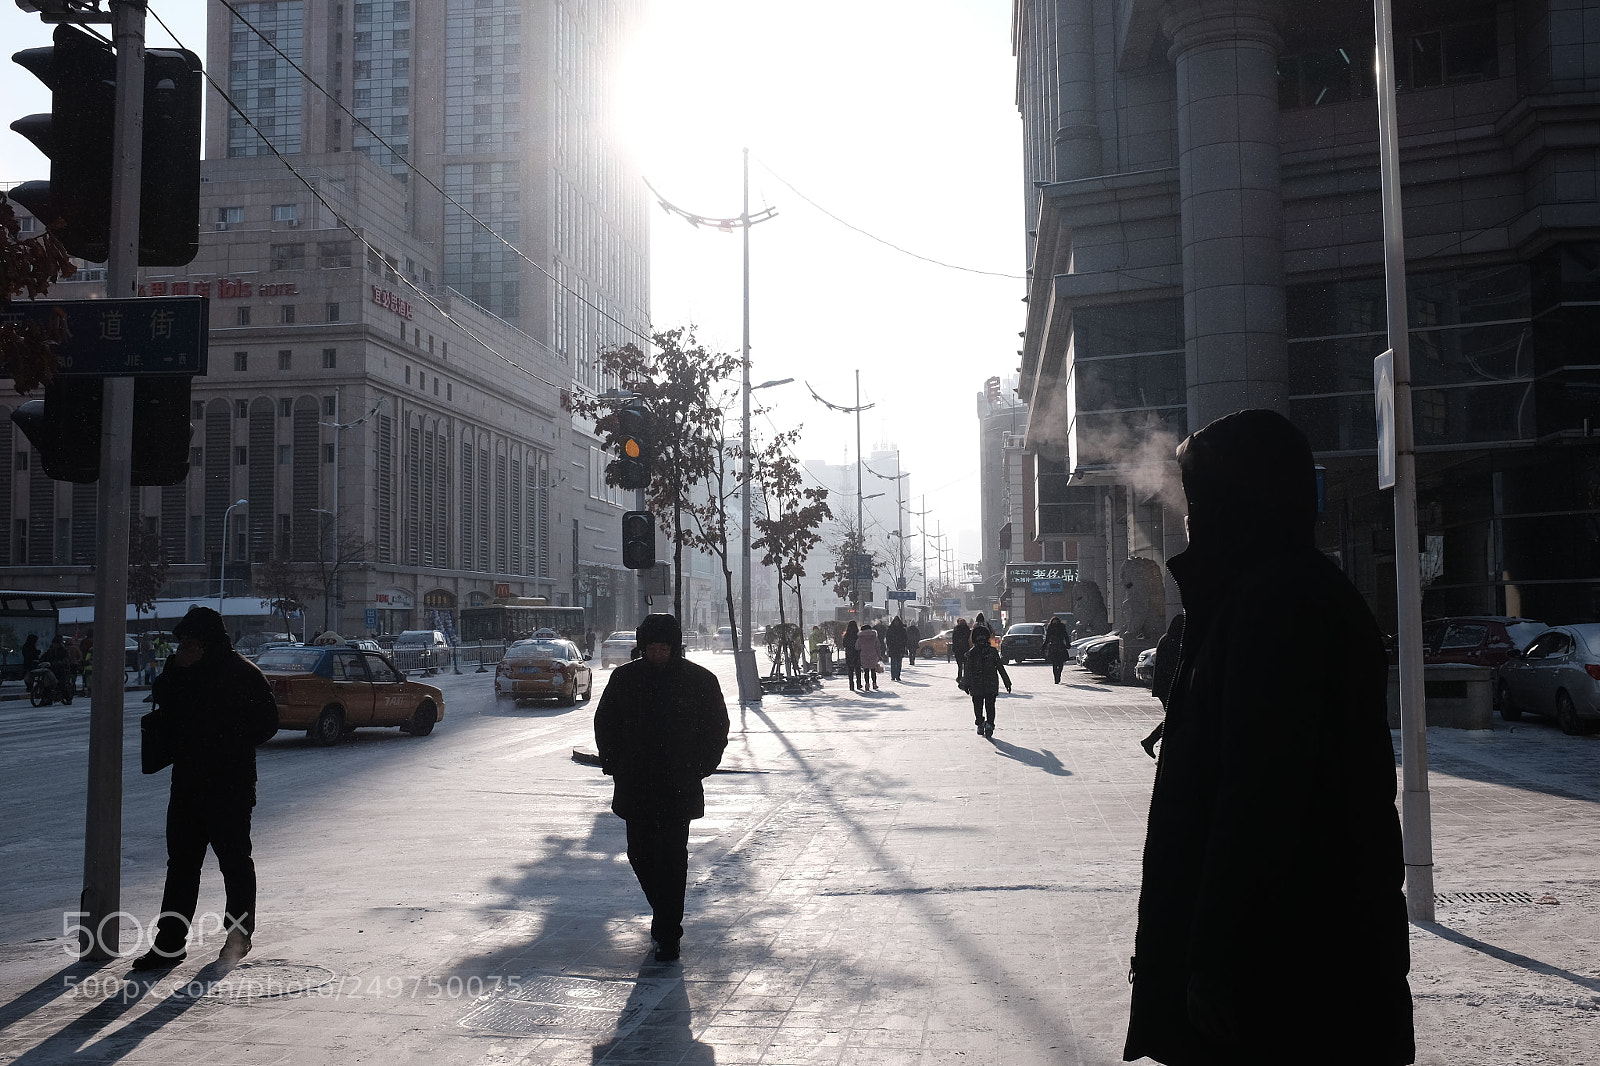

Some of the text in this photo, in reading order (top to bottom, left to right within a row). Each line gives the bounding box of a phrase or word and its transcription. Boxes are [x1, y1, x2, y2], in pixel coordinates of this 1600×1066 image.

[217, 278, 252, 299] ibis
[371, 284, 414, 321] 宜必思酒店
[1032, 568, 1080, 583] 奢侈品
[384, 696, 405, 706] TAXI
